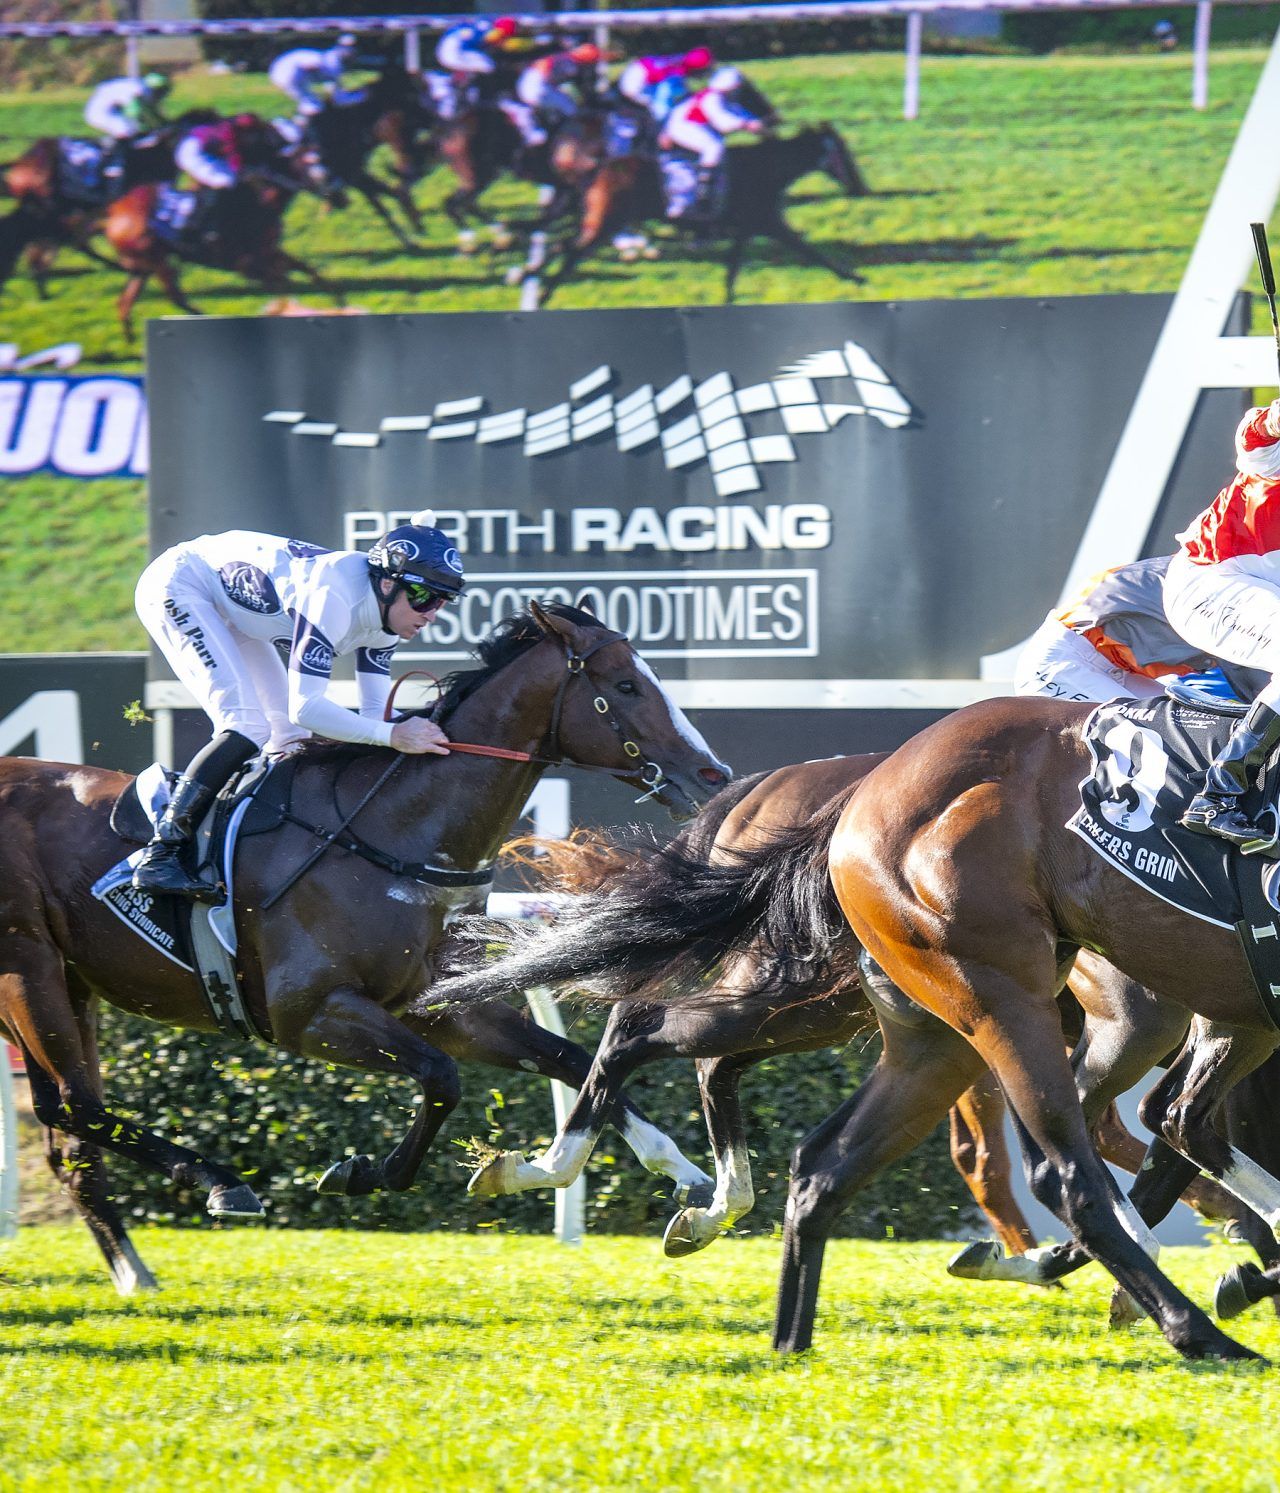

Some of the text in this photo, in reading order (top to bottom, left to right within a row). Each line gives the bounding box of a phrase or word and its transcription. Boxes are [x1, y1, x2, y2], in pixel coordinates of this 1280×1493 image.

[571, 503, 831, 552] RACING
[163, 598, 218, 669] osh Parr
[1134, 848, 1179, 883] GRIN
[128, 907, 175, 950] SYNDICATE
